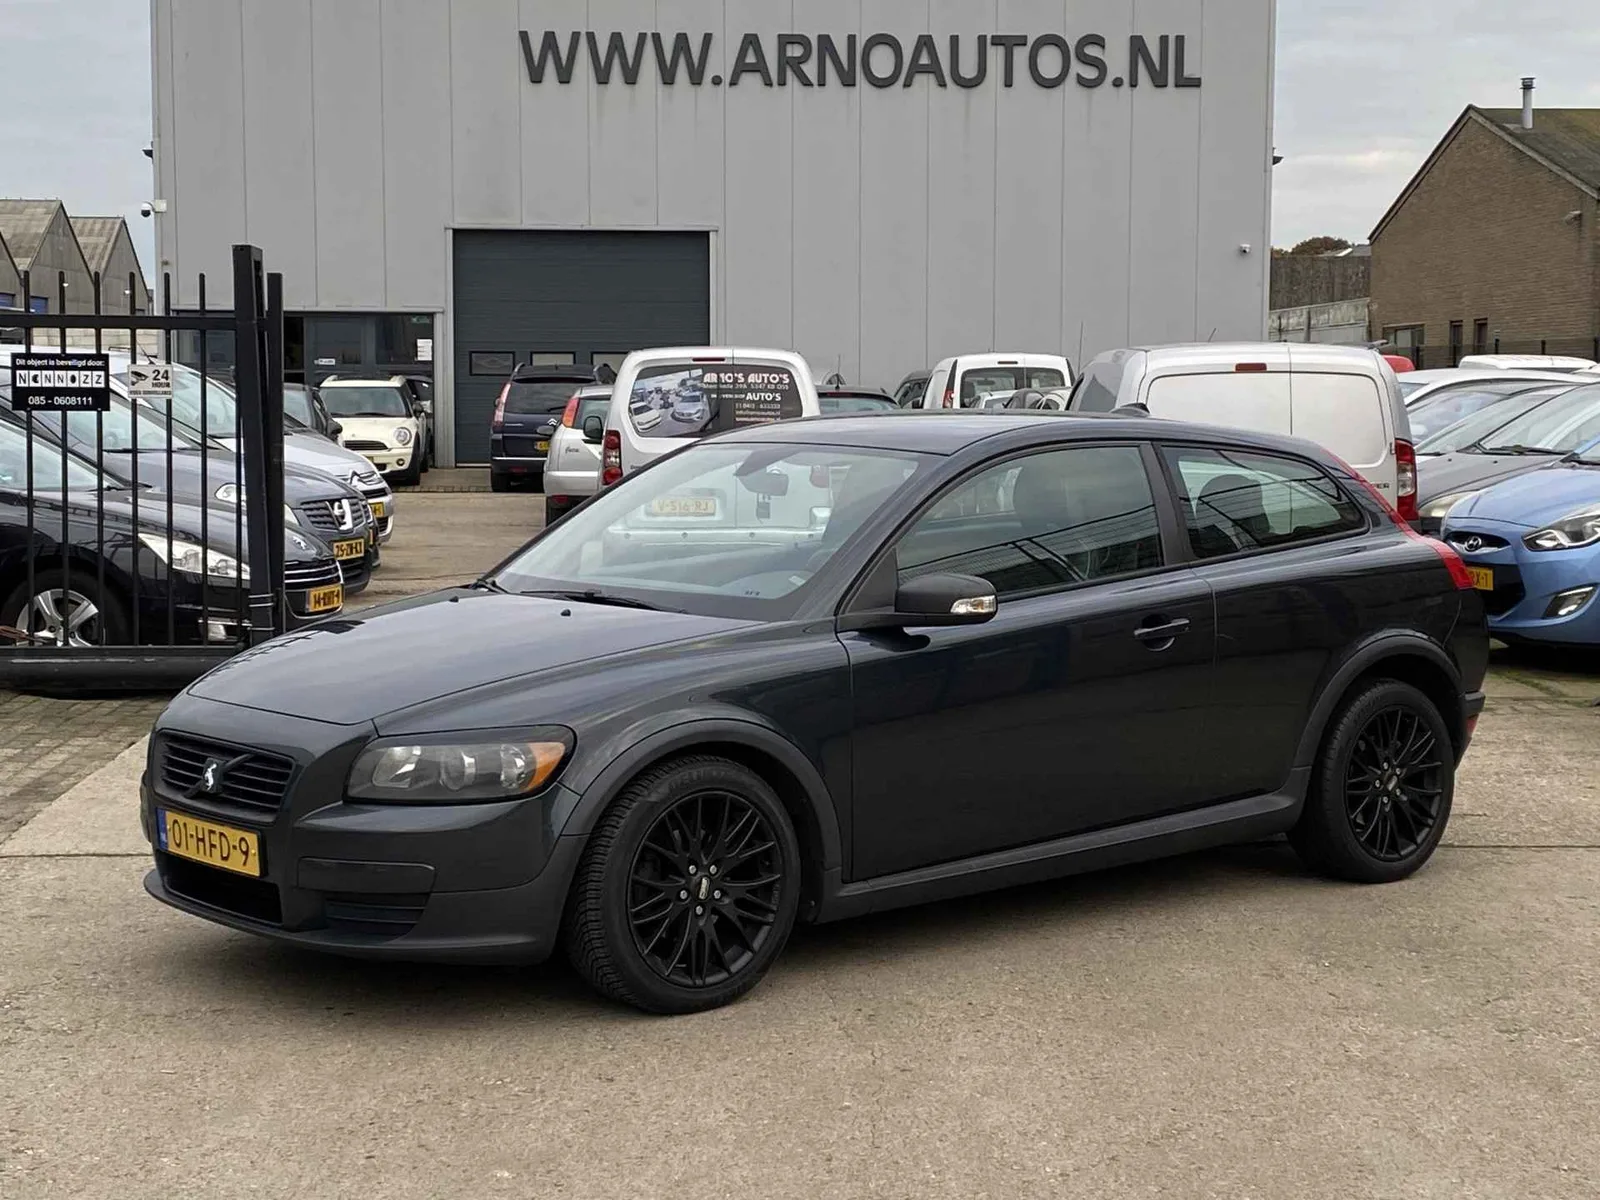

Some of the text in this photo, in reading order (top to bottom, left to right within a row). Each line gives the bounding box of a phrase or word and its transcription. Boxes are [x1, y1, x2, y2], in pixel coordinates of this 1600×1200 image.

[518, 31, 1202, 88] WWW.ARNOAUTOS.NL
[16, 358, 26, 366] Dit
[27, 359, 47, 367] object
[152, 369, 169, 381] 24
[747, 373, 790, 384] AUTO'S
[28, 396, 46, 405] 085
[746, 393, 782, 401] AUTO'S
[171, 818, 250, 867] 01-HFD-9
